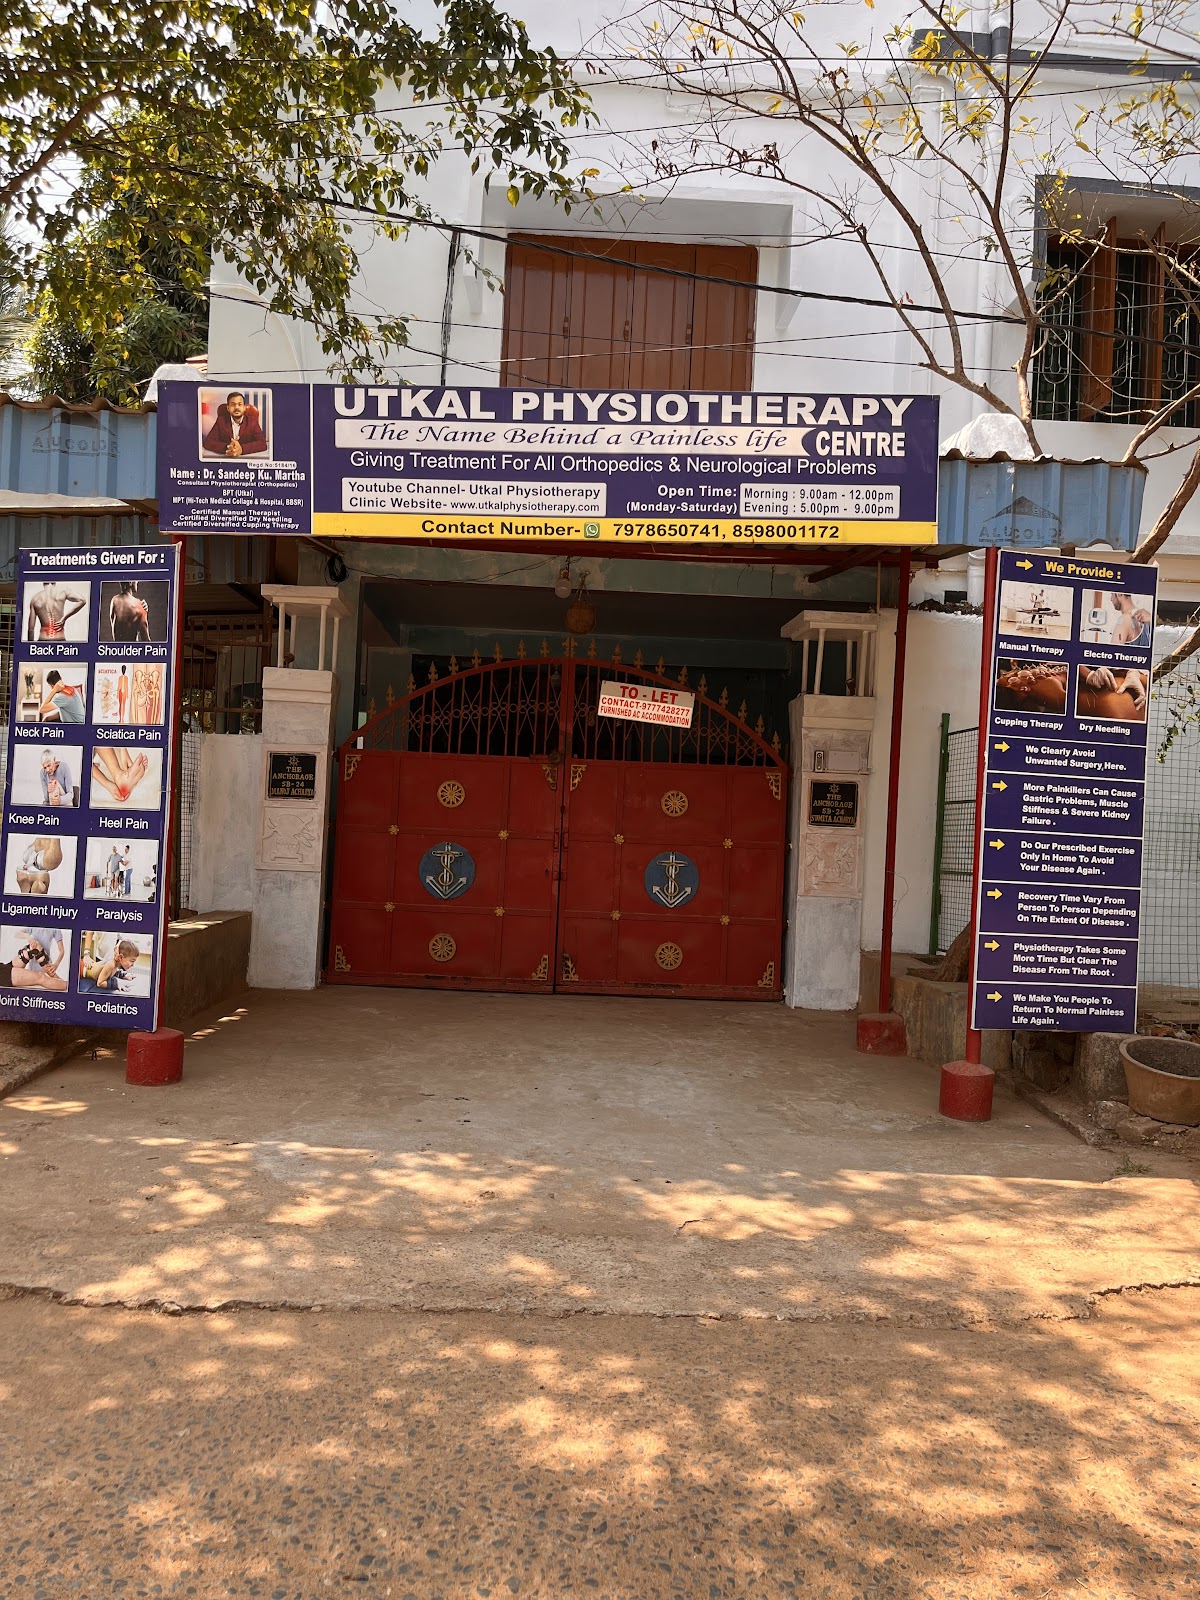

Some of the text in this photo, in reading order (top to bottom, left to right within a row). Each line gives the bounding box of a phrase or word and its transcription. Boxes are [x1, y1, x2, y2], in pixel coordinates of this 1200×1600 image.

[334, 388, 914, 426] UTKAL PHYSIOTHERAPY
[360, 422, 787, 452] The Name Behind a Painless life
[816, 430, 906, 456] CENTRE
[350, 451, 876, 477] Giving Treatment For All Orthopedics & Neurological Problems
[170, 468, 305, 482] Name Dr. Sandeep Ku. Martha
[349, 482, 600, 498] Youtube Channel- Utkal Physiotherapy
[658, 485, 737, 498] Open Time:
[744, 488, 894, 502] Morning 9.00am 12.00pm
[350, 497, 599, 512] Clinic Website- www.utkalphysiotherapy.com
[626, 502, 737, 514] (Monday-Saturday)
[744, 502, 894, 516] Evening 5.00pm 9.00pm
[422, 520, 839, 539] Contact Number- 7978650741, 8598001172
[30, 551, 157, 566] Treatments Given For
[1045, 561, 1114, 578] We Provide
[30, 645, 78, 656] Back Pain
[98, 645, 167, 656] Shoulder Pain
[999, 642, 1064, 656] Manual Therapy
[1084, 650, 1147, 663] Electro Therapy
[620, 686, 678, 705] TO LET
[600, 706, 631, 717] FURNISHED
[995, 717, 1063, 730] Cupping Therapy
[1095, 725, 1130, 735] Needling
[15, 727, 64, 738] Neck Pain
[96, 728, 161, 740] Sciatica Pain
[1041, 746, 1095, 757] Clearly Avoid
[1026, 757, 1068, 766] Unwanted
[1047, 784, 1090, 794] Painkillers
[1111, 789, 1136, 797] Cause
[1023, 794, 1128, 808] Gastric Problems, Muscle
[9, 813, 60, 825] Knee Pain
[1022, 805, 1130, 820] Stiffness Severe Kidney
[100, 817, 148, 829] Heel Pain
[1022, 816, 1051, 825] Failure
[1052, 842, 1134, 854] Prescribed Exercise
[1020, 852, 1114, 864] Only Home Avoid
[1020, 863, 1100, 875] Your Disease Again
[1019, 892, 1058, 902] Recovery
[1083, 895, 1102, 904] Vary
[2, 902, 78, 919] Ligament Injury
[96, 908, 142, 923] Paralysis
[1018, 904, 1047, 912] Person
[1093, 907, 1136, 917] Depending
[1050, 916, 1124, 926] Extent Disease
[1014, 943, 1126, 955] Physiotherapy Takes Some
[1013, 954, 1035, 962] More
[1037, 955, 1058, 963] Time
[1013, 966, 1046, 974] Disease
[1048, 967, 1070, 975] From
[22, 996, 66, 1010] Stiffness
[1071, 996, 1099, 1005] People
[87, 1001, 138, 1015] Pediatrics
[1013, 1006, 1124, 1016] Return Normal Painless
[1012, 1016, 1054, 1026] Life Again
